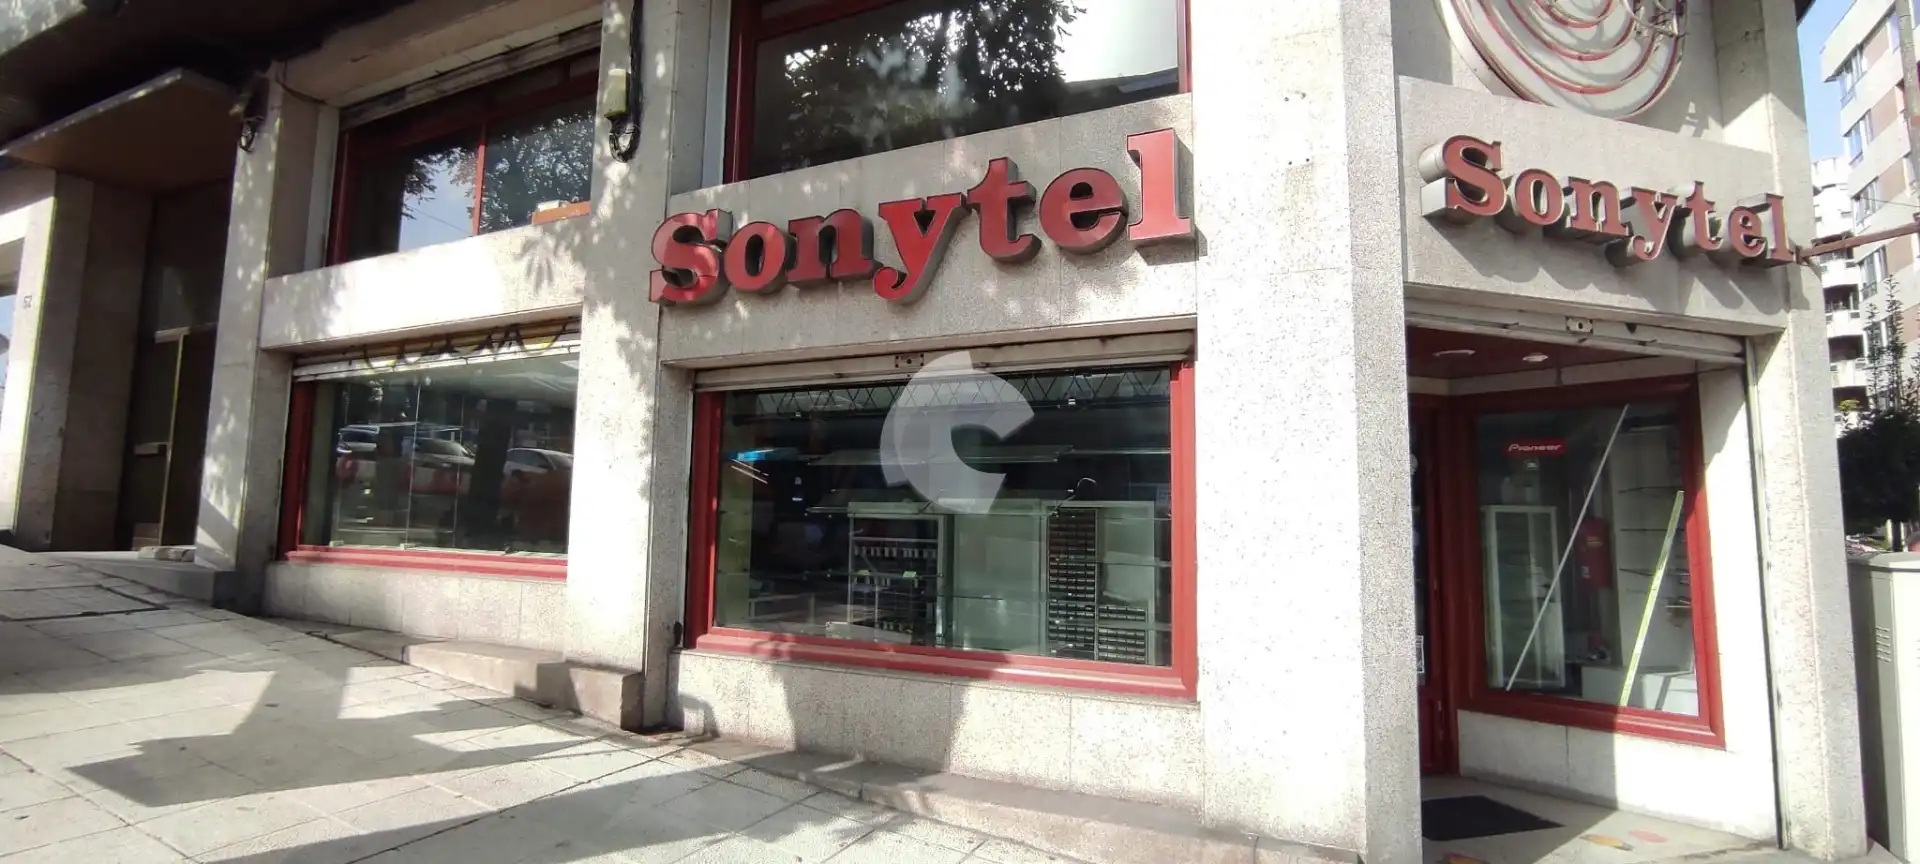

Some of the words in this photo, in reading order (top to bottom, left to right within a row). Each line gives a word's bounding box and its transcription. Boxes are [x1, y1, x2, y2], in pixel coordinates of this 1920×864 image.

[649, 127, 1192, 303] Sonytel
[1438, 134, 1796, 263] Sonytel
[1508, 443, 1562, 452] Pioneer
